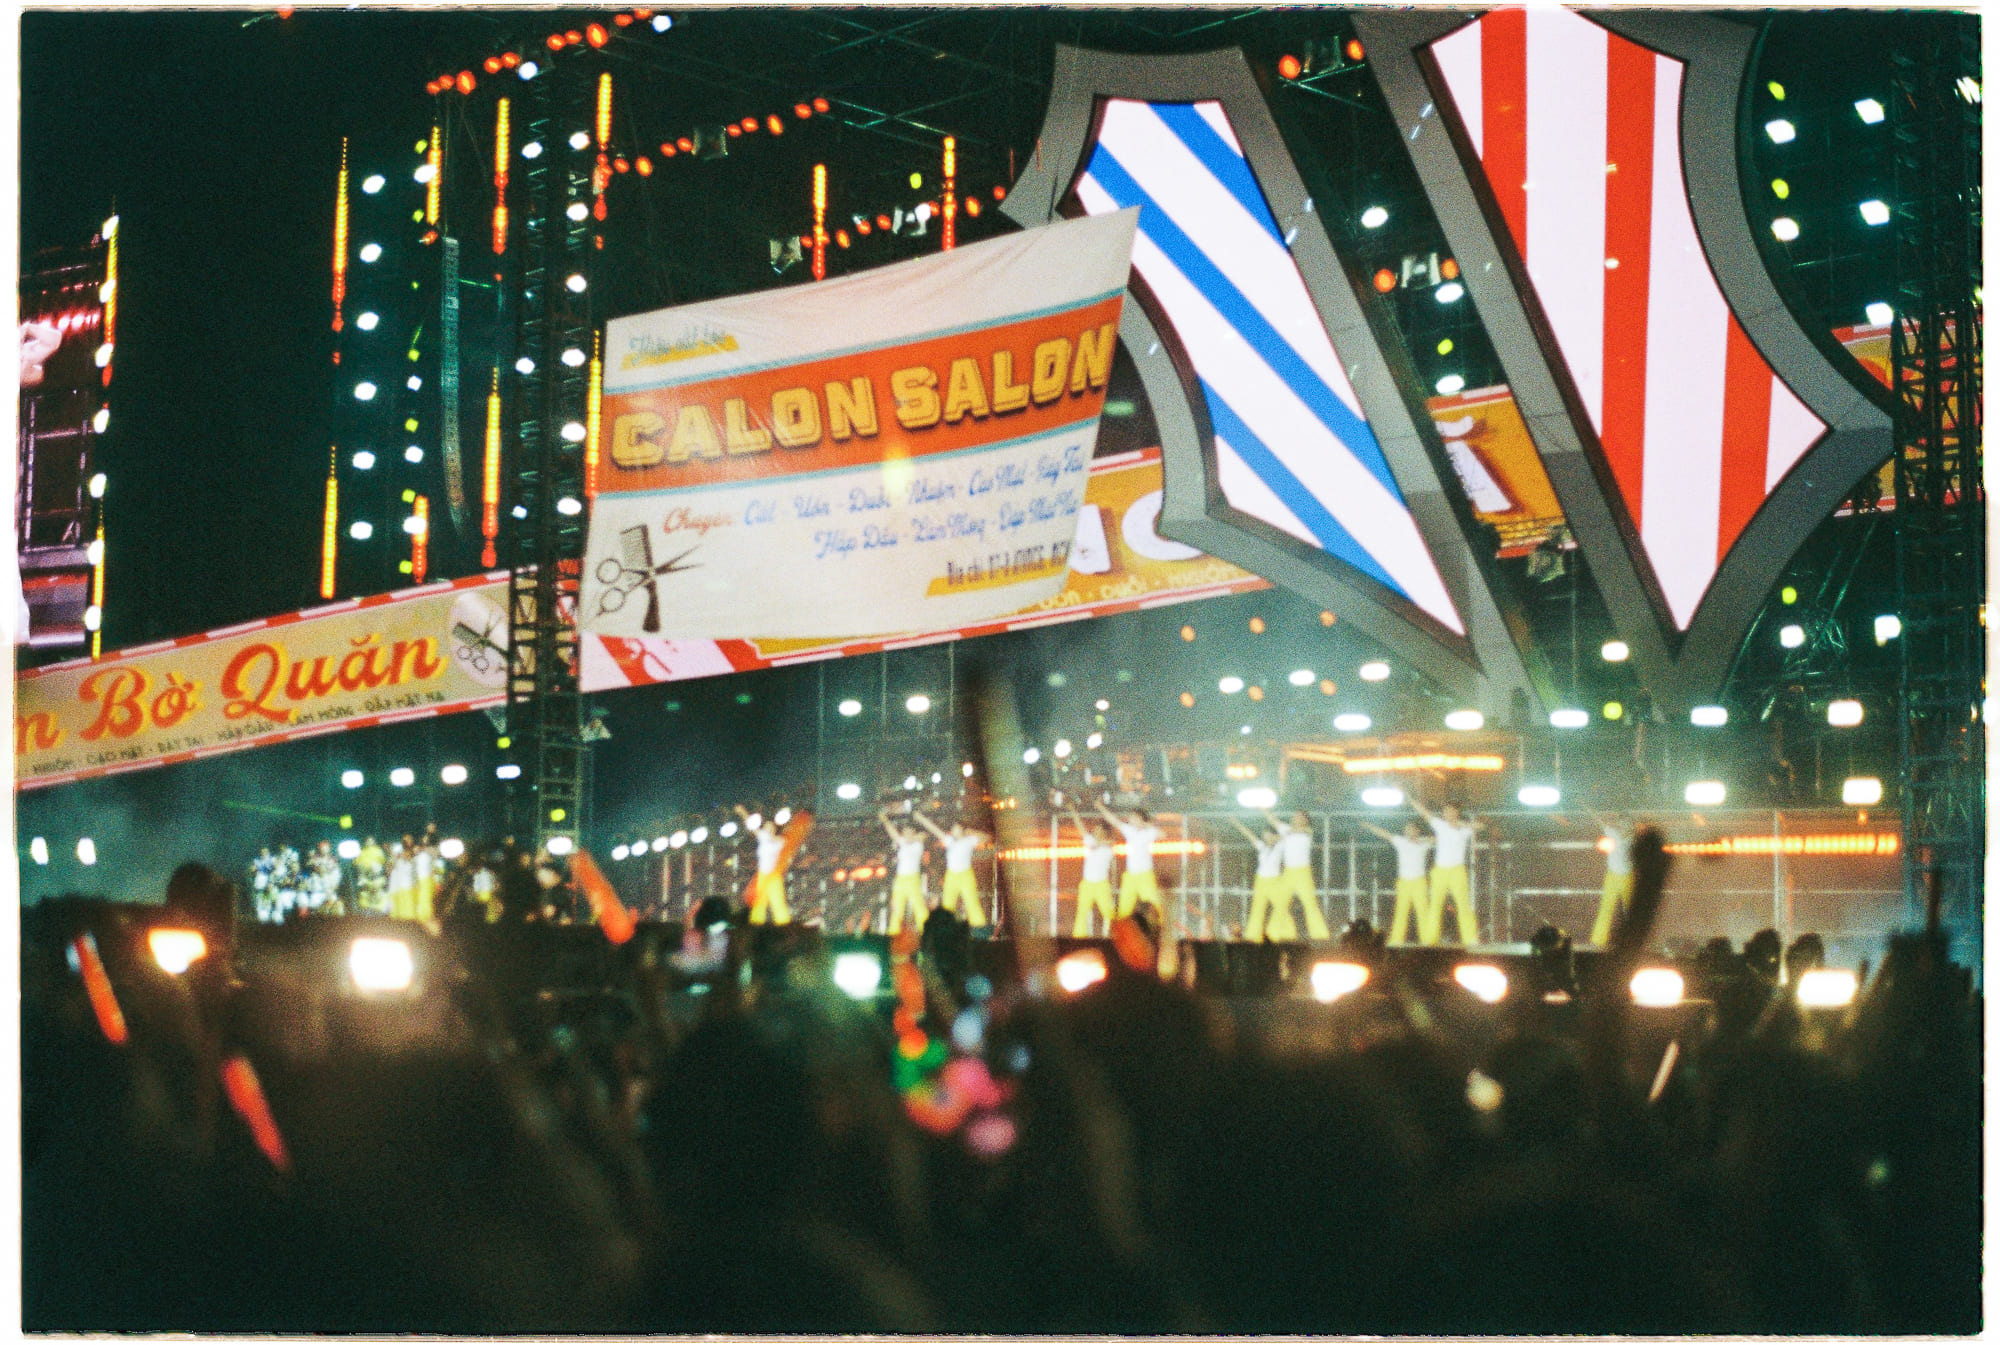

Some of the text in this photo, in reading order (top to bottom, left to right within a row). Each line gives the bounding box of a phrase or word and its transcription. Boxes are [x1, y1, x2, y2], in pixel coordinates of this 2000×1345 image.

[611, 322, 1116, 470] CALON SALON
[78, 665, 204, 742] Bò
[220, 633, 450, 724] Quăn
